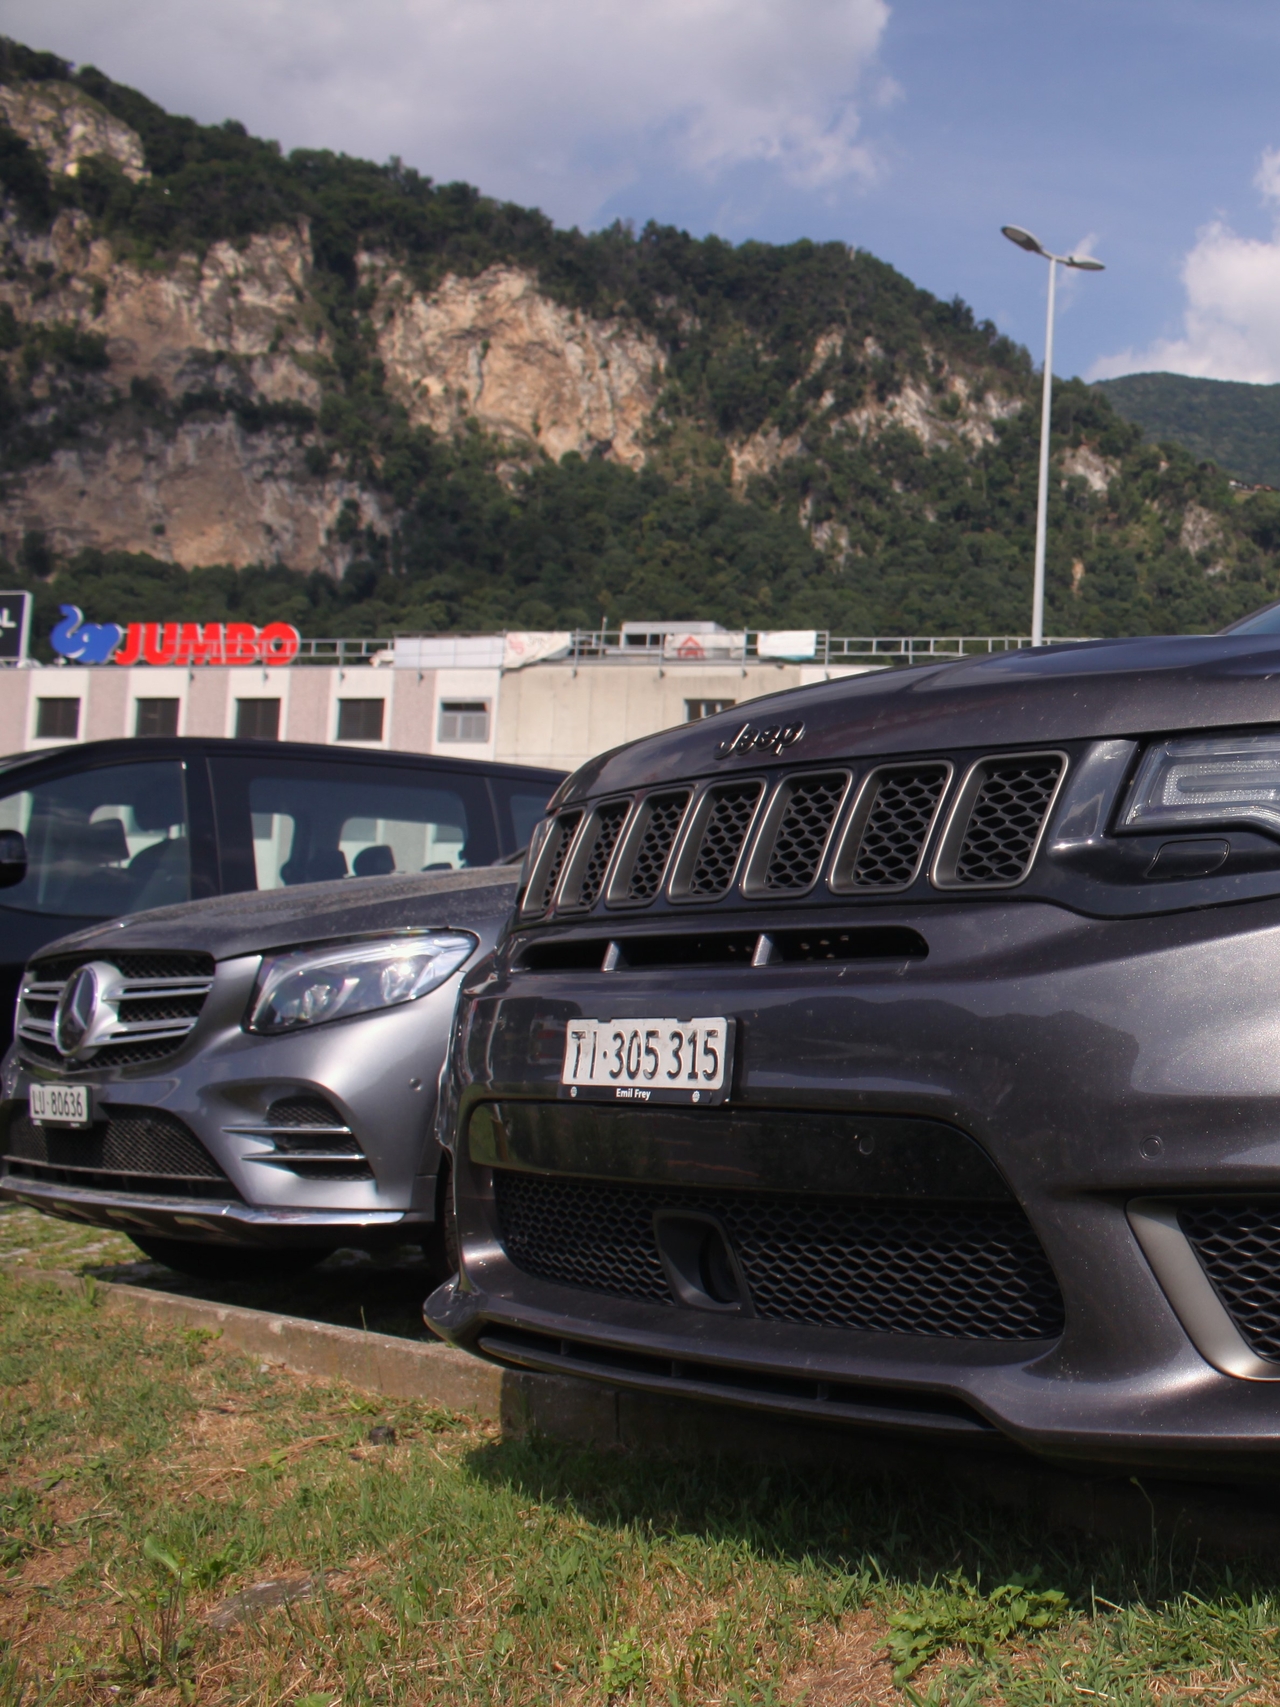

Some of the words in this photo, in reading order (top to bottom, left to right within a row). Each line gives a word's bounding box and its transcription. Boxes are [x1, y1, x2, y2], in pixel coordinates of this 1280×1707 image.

[115, 622, 298, 666] JUMBO
[713, 721, 806, 760] Jeep
[616, 1087, 634, 1098] Emil
[634, 1088, 652, 1101] Frey
